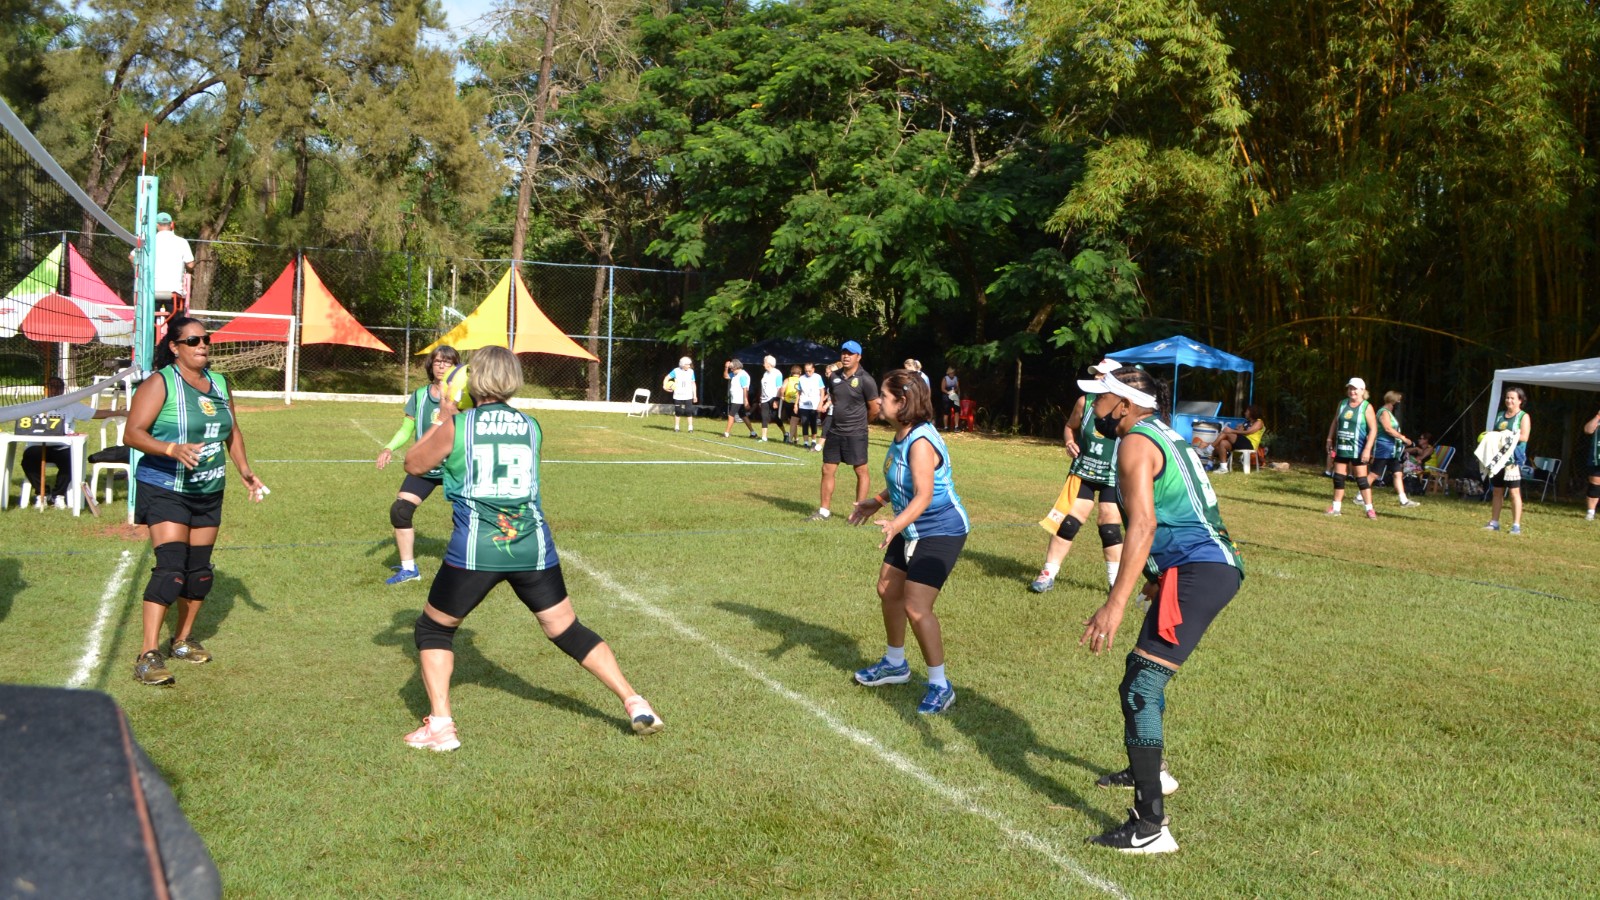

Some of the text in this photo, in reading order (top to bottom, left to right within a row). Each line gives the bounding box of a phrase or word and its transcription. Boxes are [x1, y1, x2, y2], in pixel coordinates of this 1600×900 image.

[19, 416, 31, 428] 8
[49, 417, 60, 429] 7
[479, 409, 524, 423] ATIBA
[475, 421, 528, 436] BAURU
[1089, 441, 1104, 456] 14
[470, 443, 533, 498] 13
